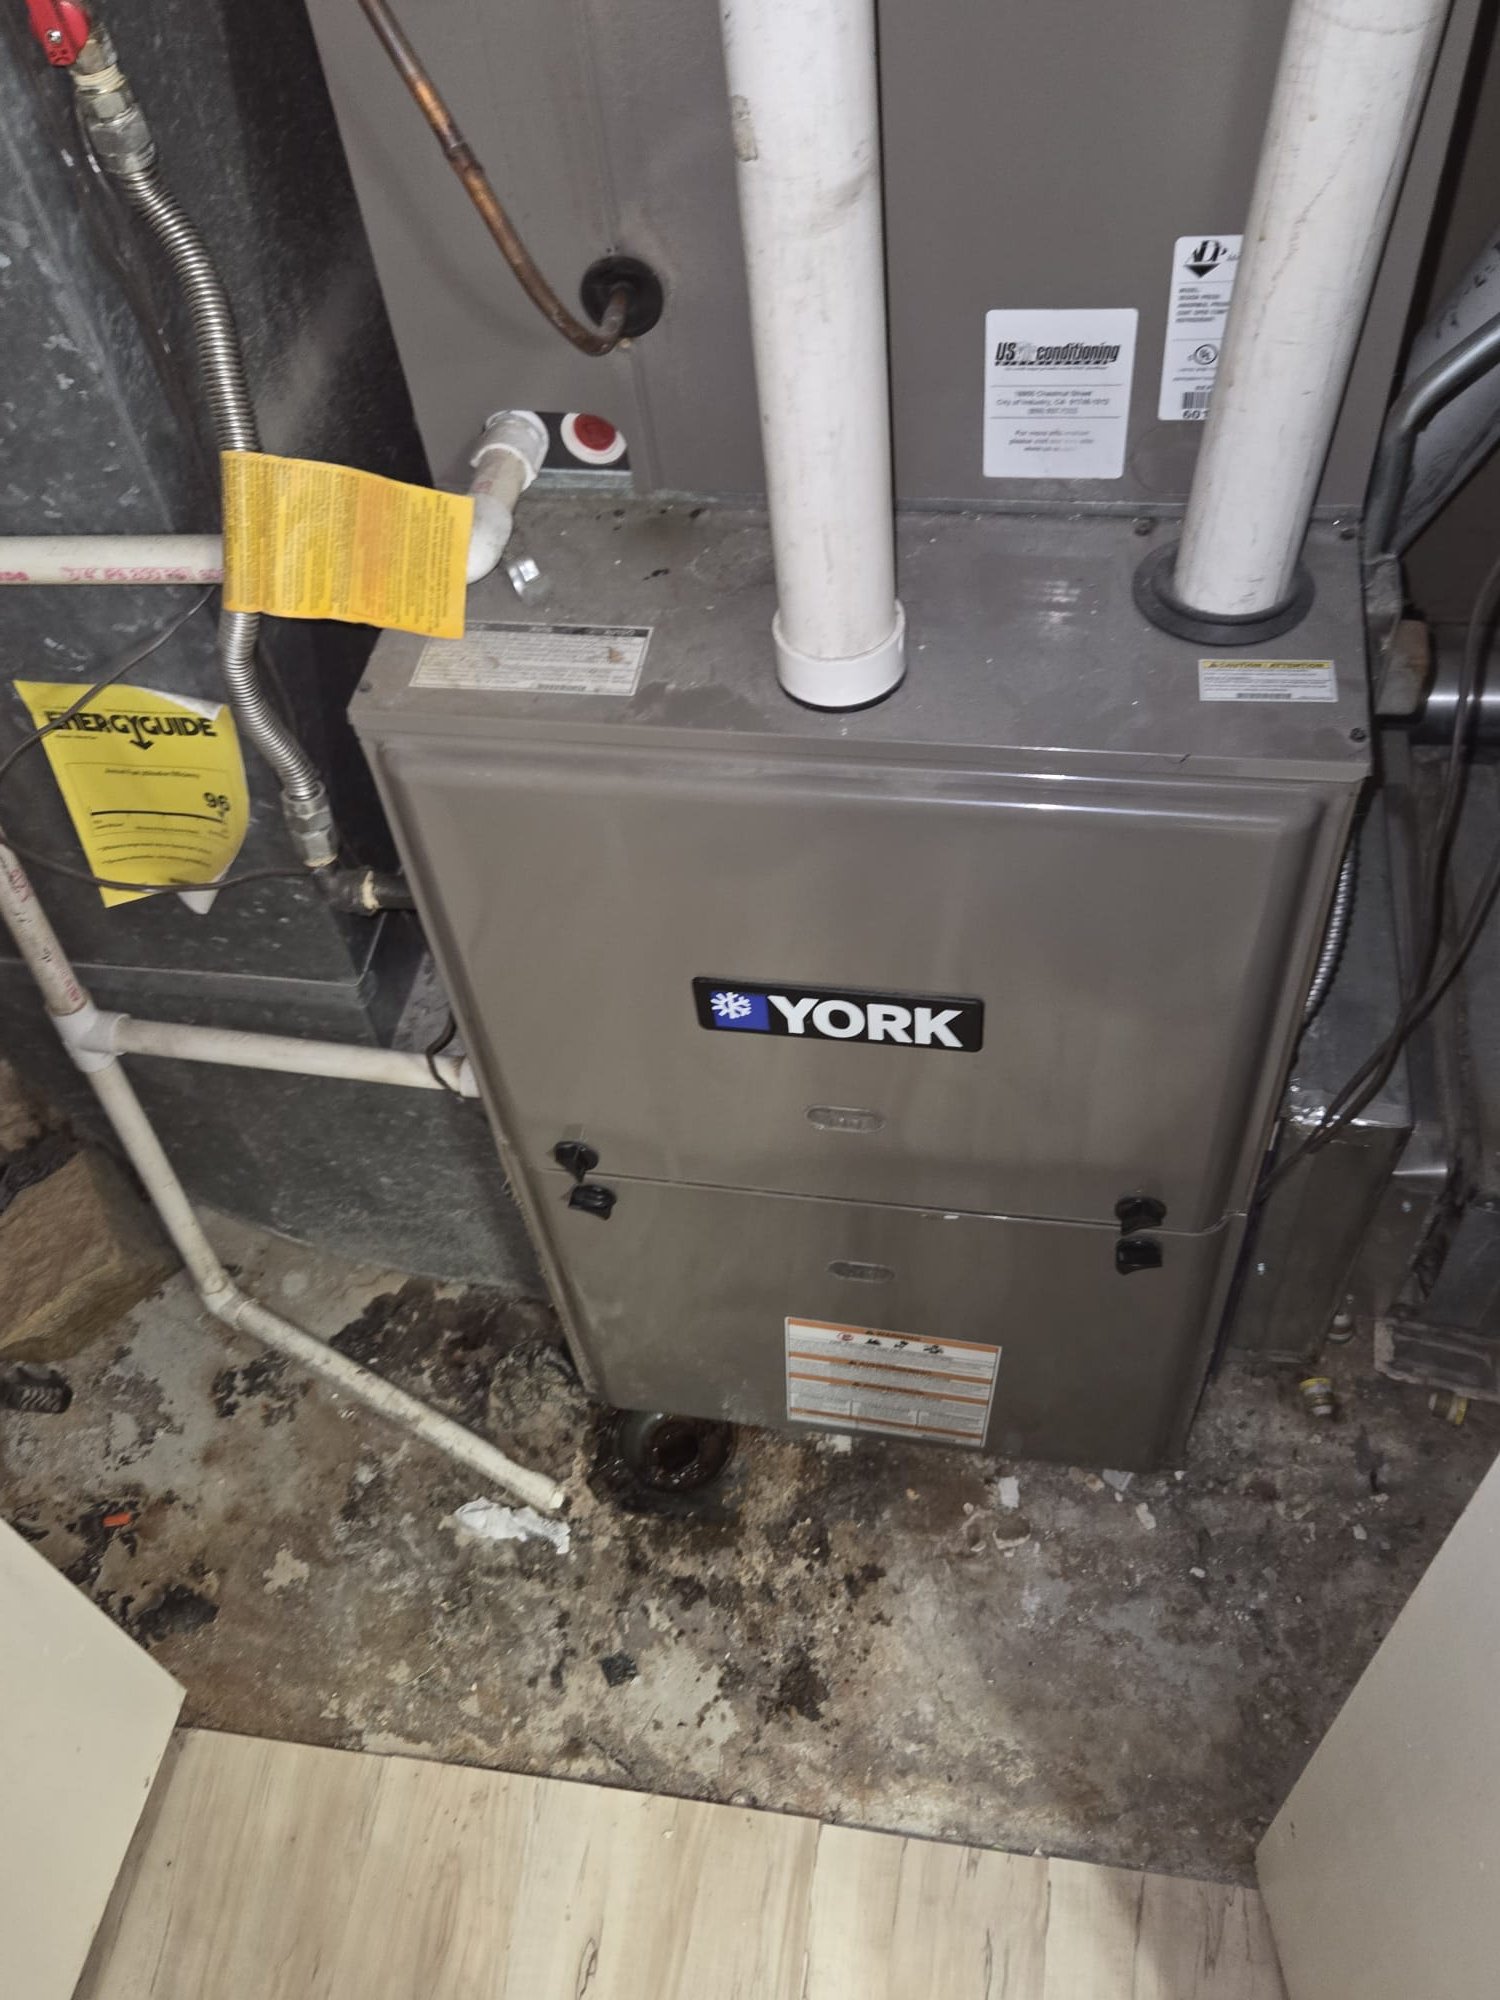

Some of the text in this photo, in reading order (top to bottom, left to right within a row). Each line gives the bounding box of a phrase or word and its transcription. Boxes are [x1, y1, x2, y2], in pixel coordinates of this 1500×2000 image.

[995, 342, 1121, 362] US conditioning
[203, 792, 231, 811] 96
[767, 994, 964, 1048] YORK
